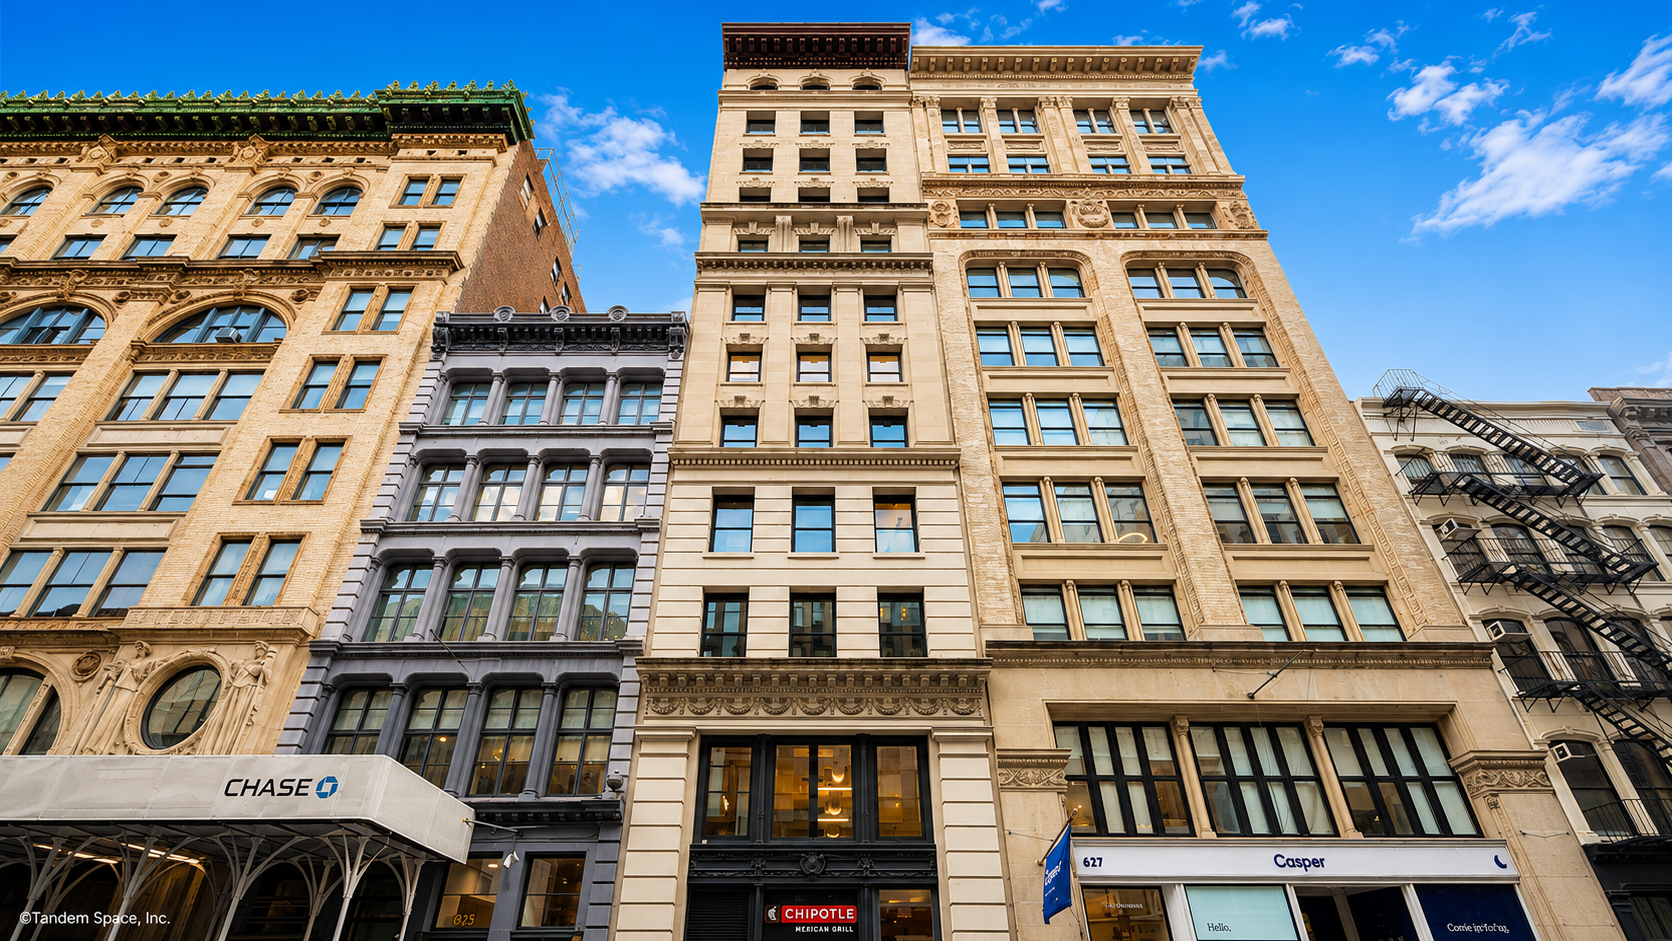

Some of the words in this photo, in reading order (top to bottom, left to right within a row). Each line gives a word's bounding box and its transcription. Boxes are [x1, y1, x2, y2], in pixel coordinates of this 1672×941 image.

[224, 778, 314, 797] CHASE
[1083, 857, 1103, 868] 627
[1273, 853, 1326, 872] Casper
[785, 908, 854, 919] CHIPOTLE
[1206, 922, 1232, 932] Hello.
